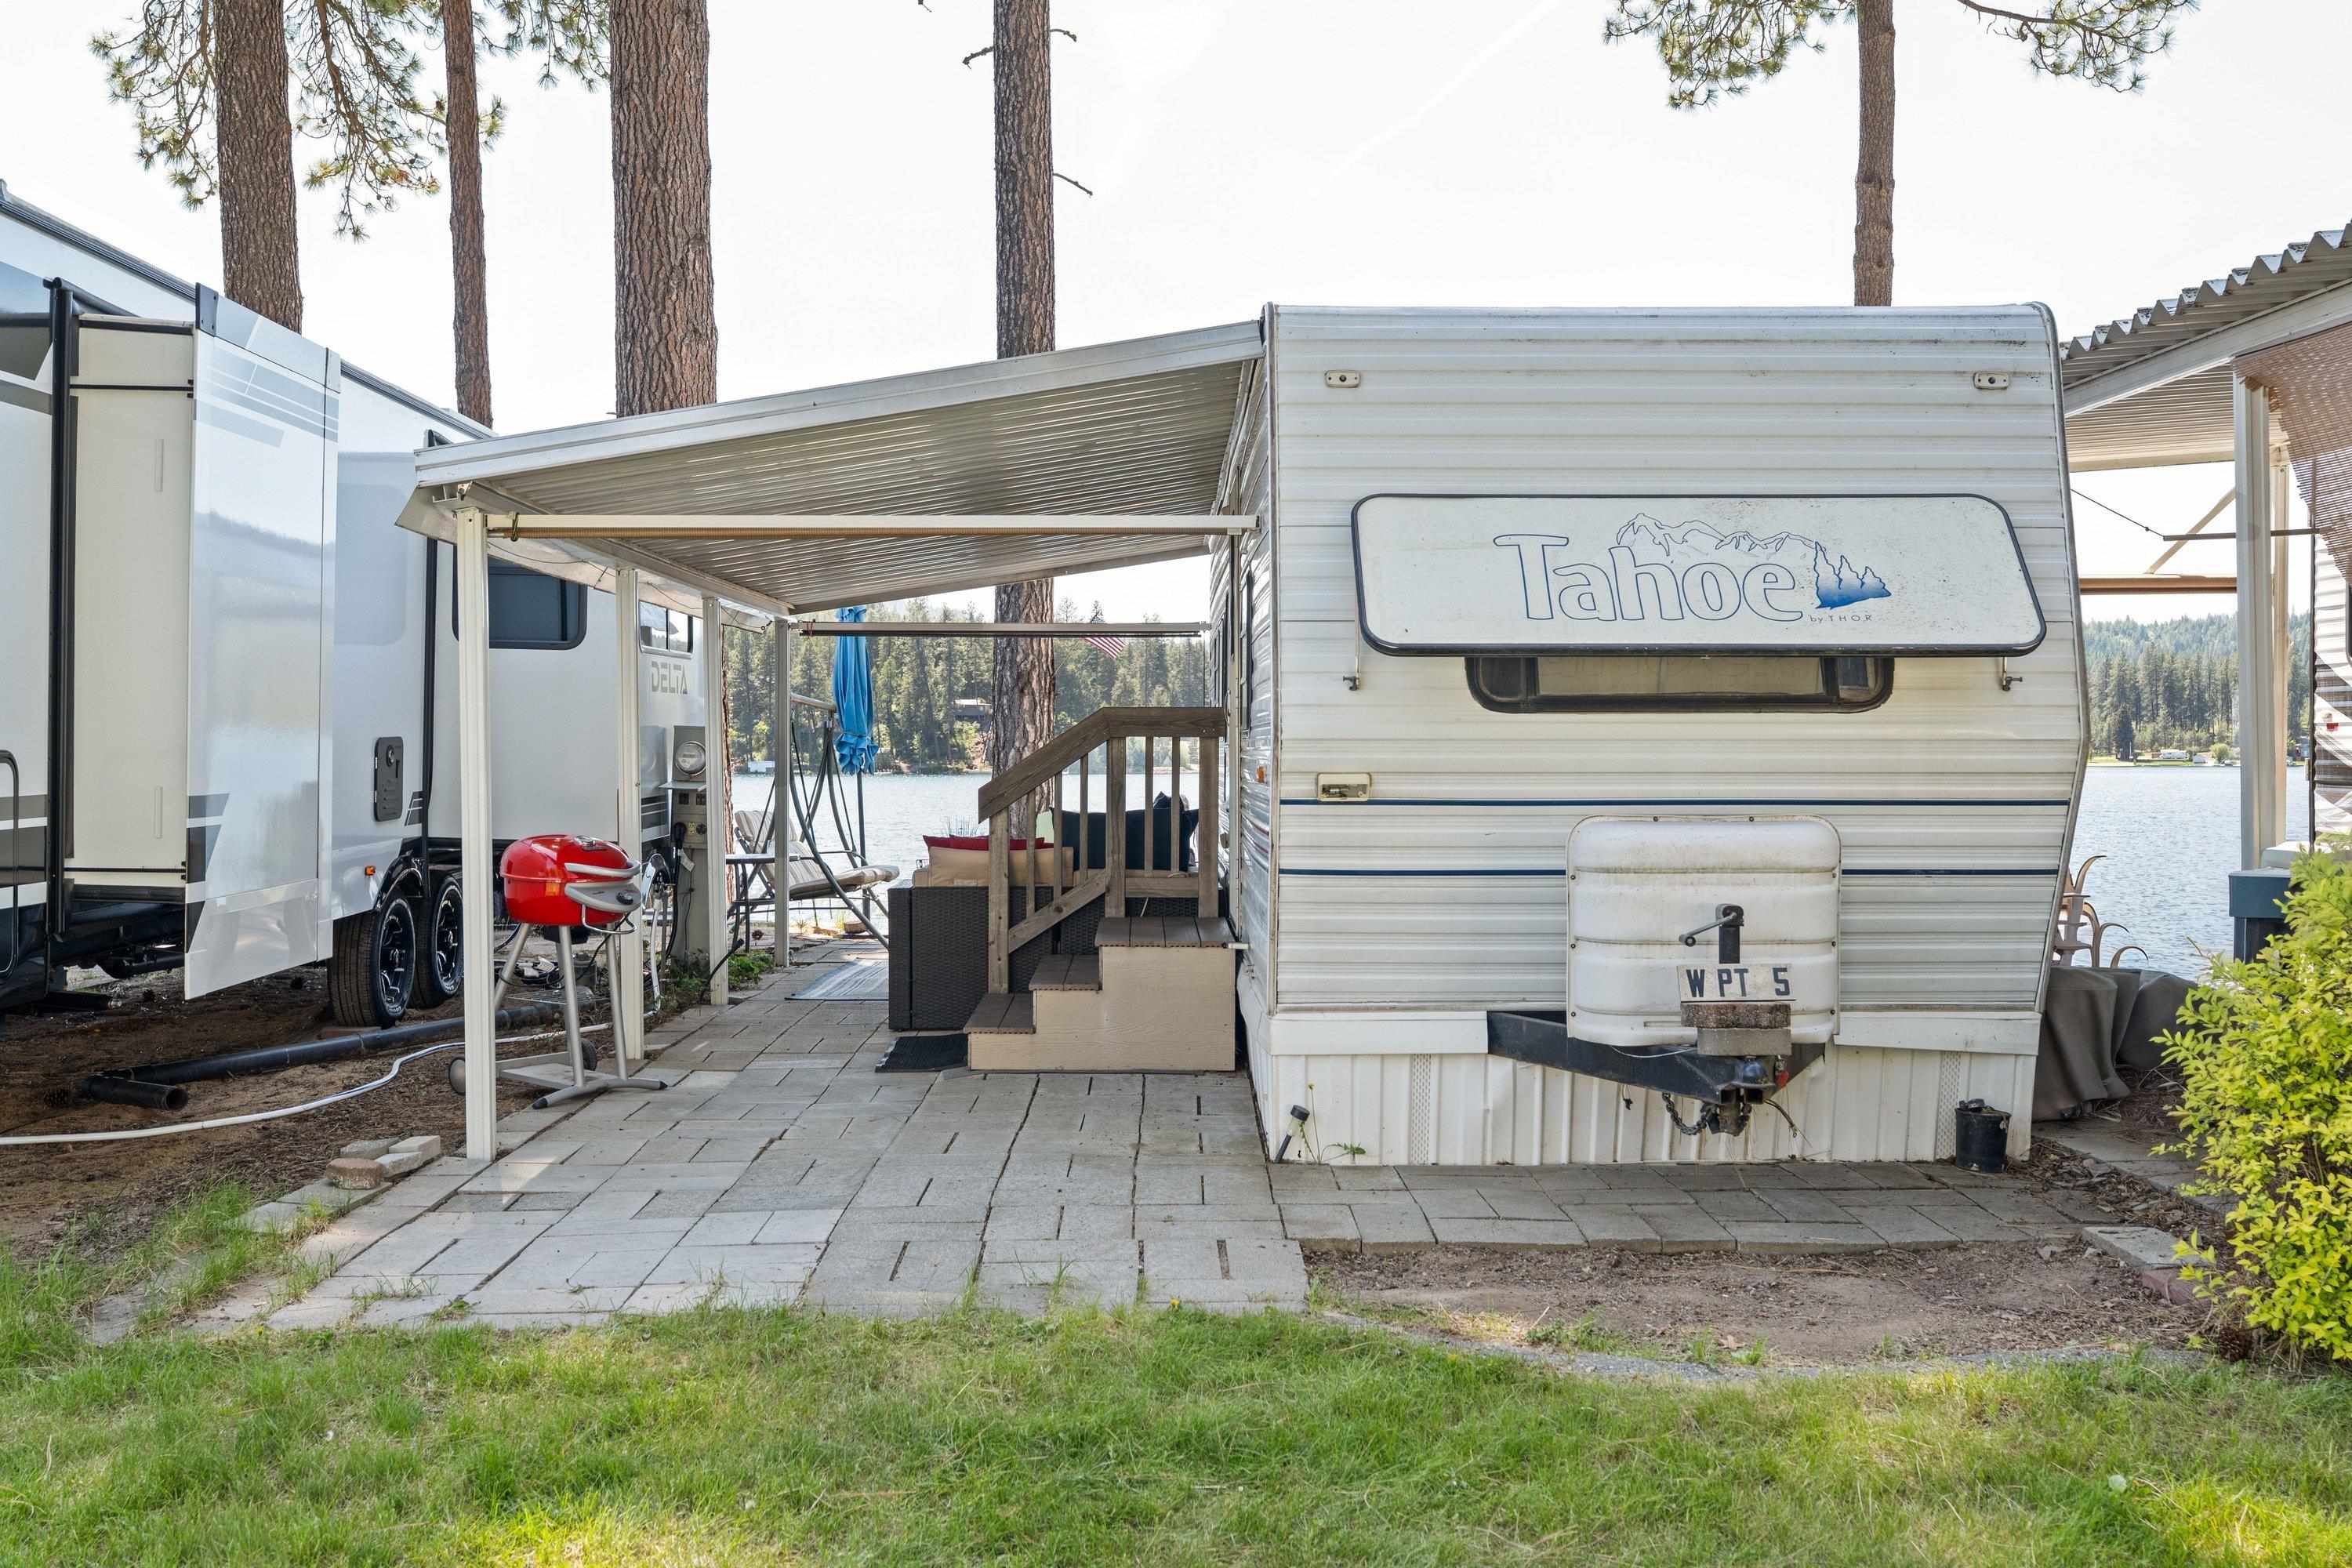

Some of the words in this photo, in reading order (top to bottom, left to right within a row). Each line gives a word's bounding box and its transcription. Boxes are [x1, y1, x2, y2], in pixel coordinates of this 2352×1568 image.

[1493, 534, 1803, 622] Tahoe
[1809, 615, 1823, 623] by
[652, 661, 688, 695] DELTA
